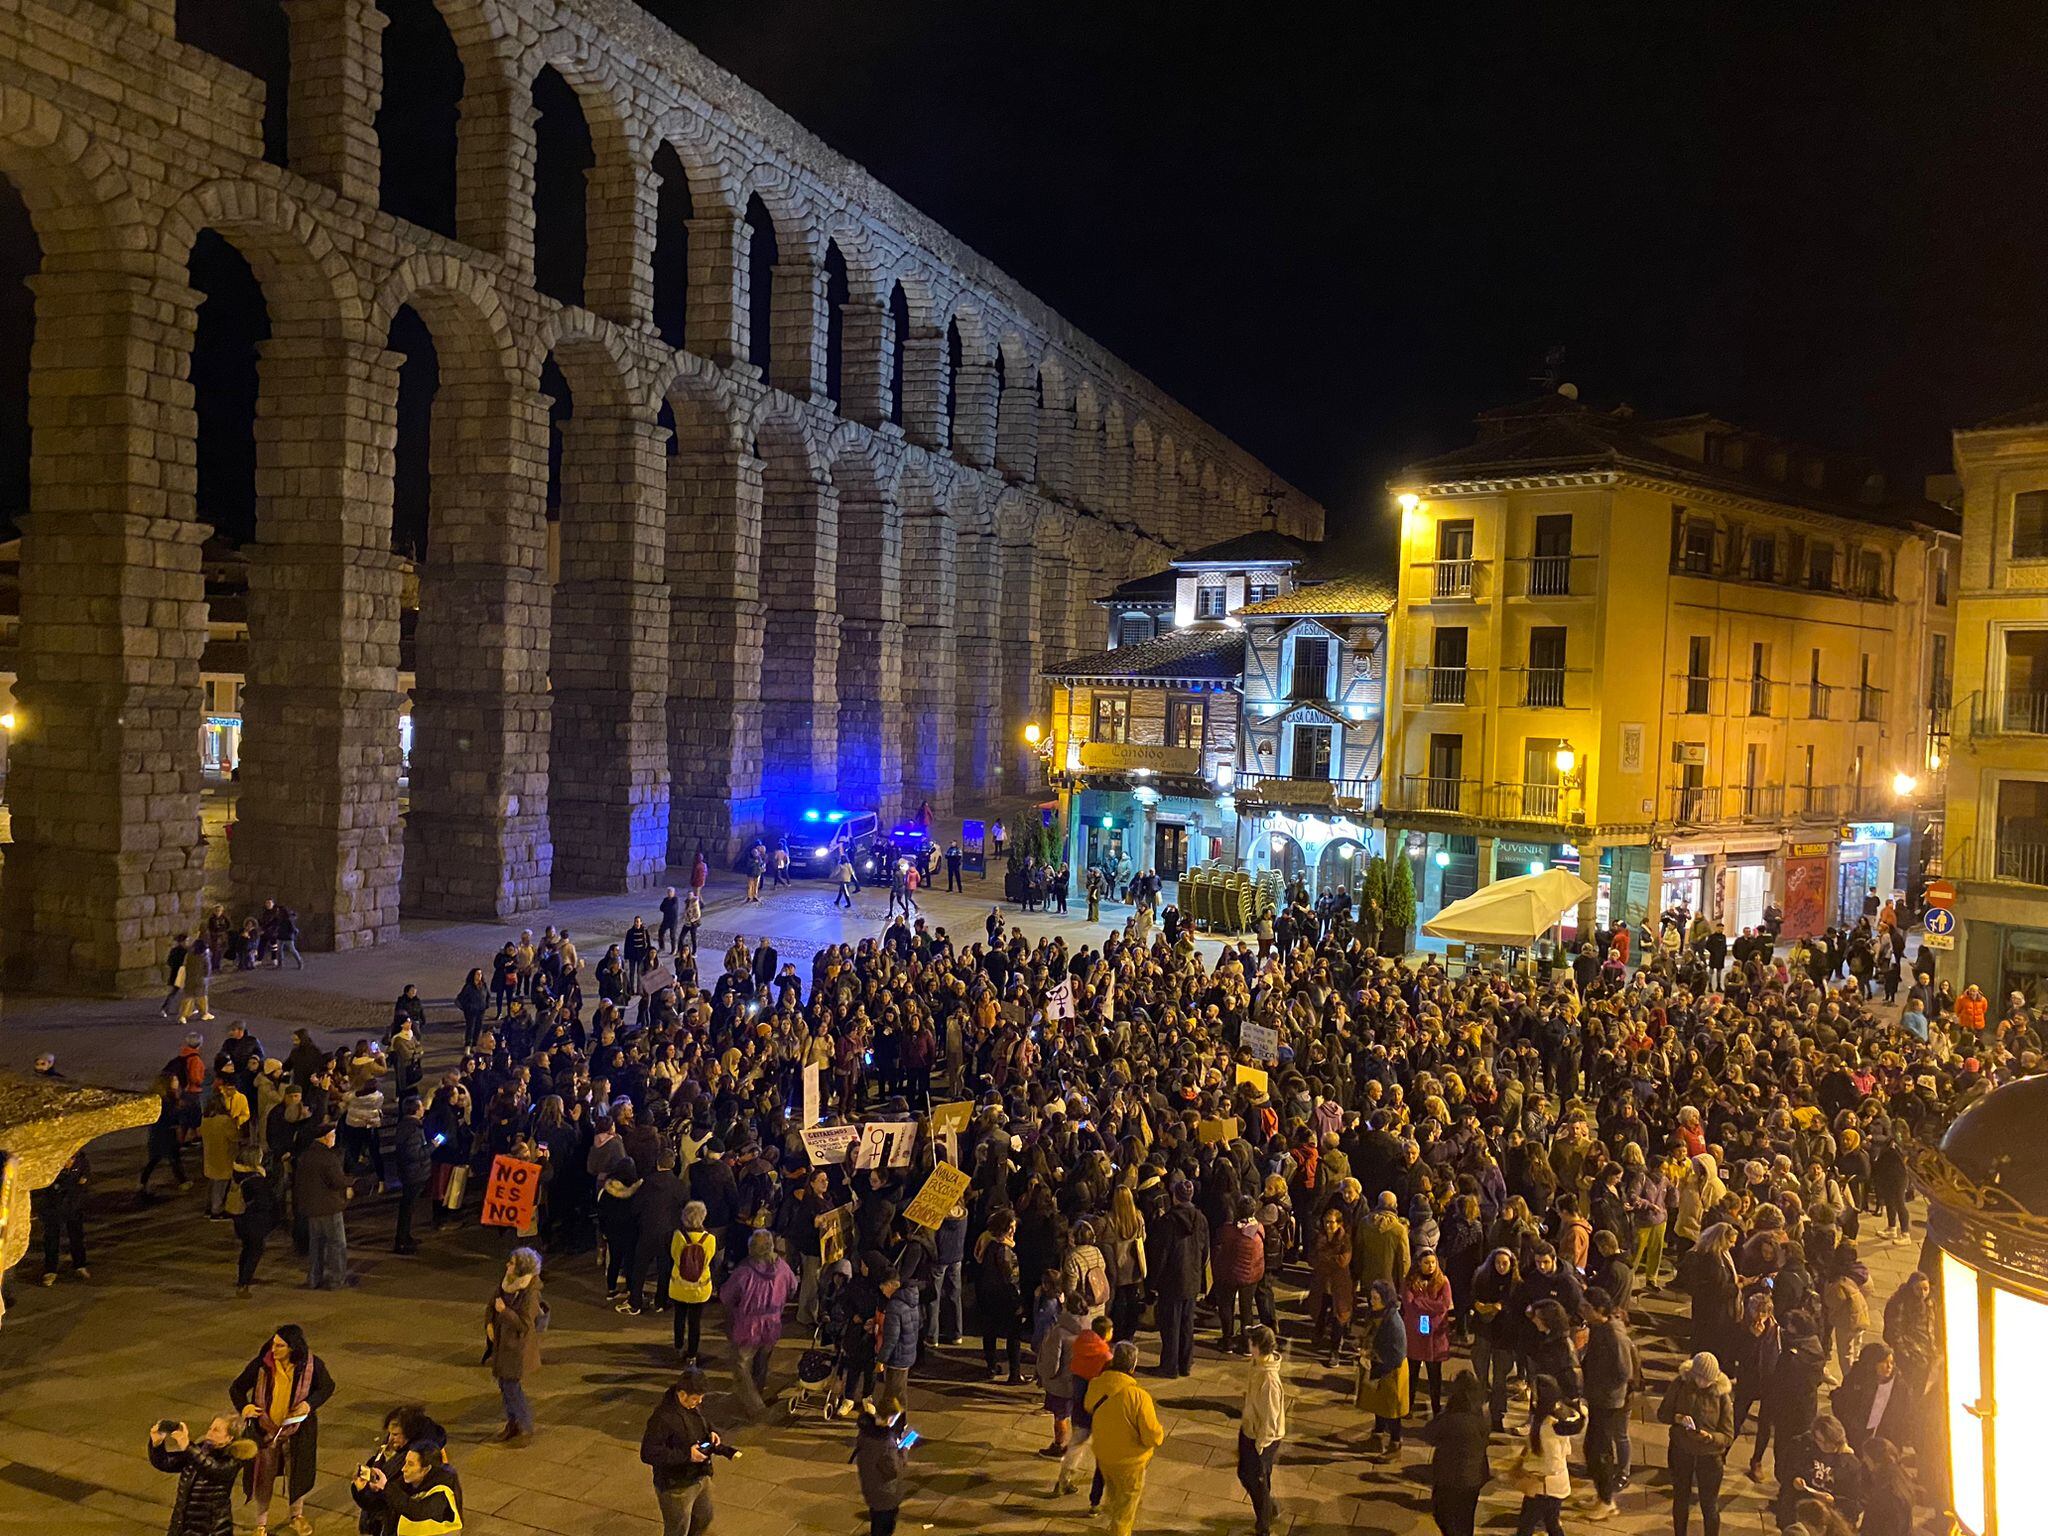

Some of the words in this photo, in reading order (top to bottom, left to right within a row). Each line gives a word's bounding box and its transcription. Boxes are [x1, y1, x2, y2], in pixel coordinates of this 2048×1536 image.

[1286, 710, 1304, 723] CASA
[1250, 817, 1305, 841] HORNO
[1305, 841, 1316, 851] DE
[1326, 824, 1375, 858] AAR
[496, 1161, 528, 1185] NO
[934, 1164, 960, 1184] AVANZA
[495, 1185, 521, 1202] ES
